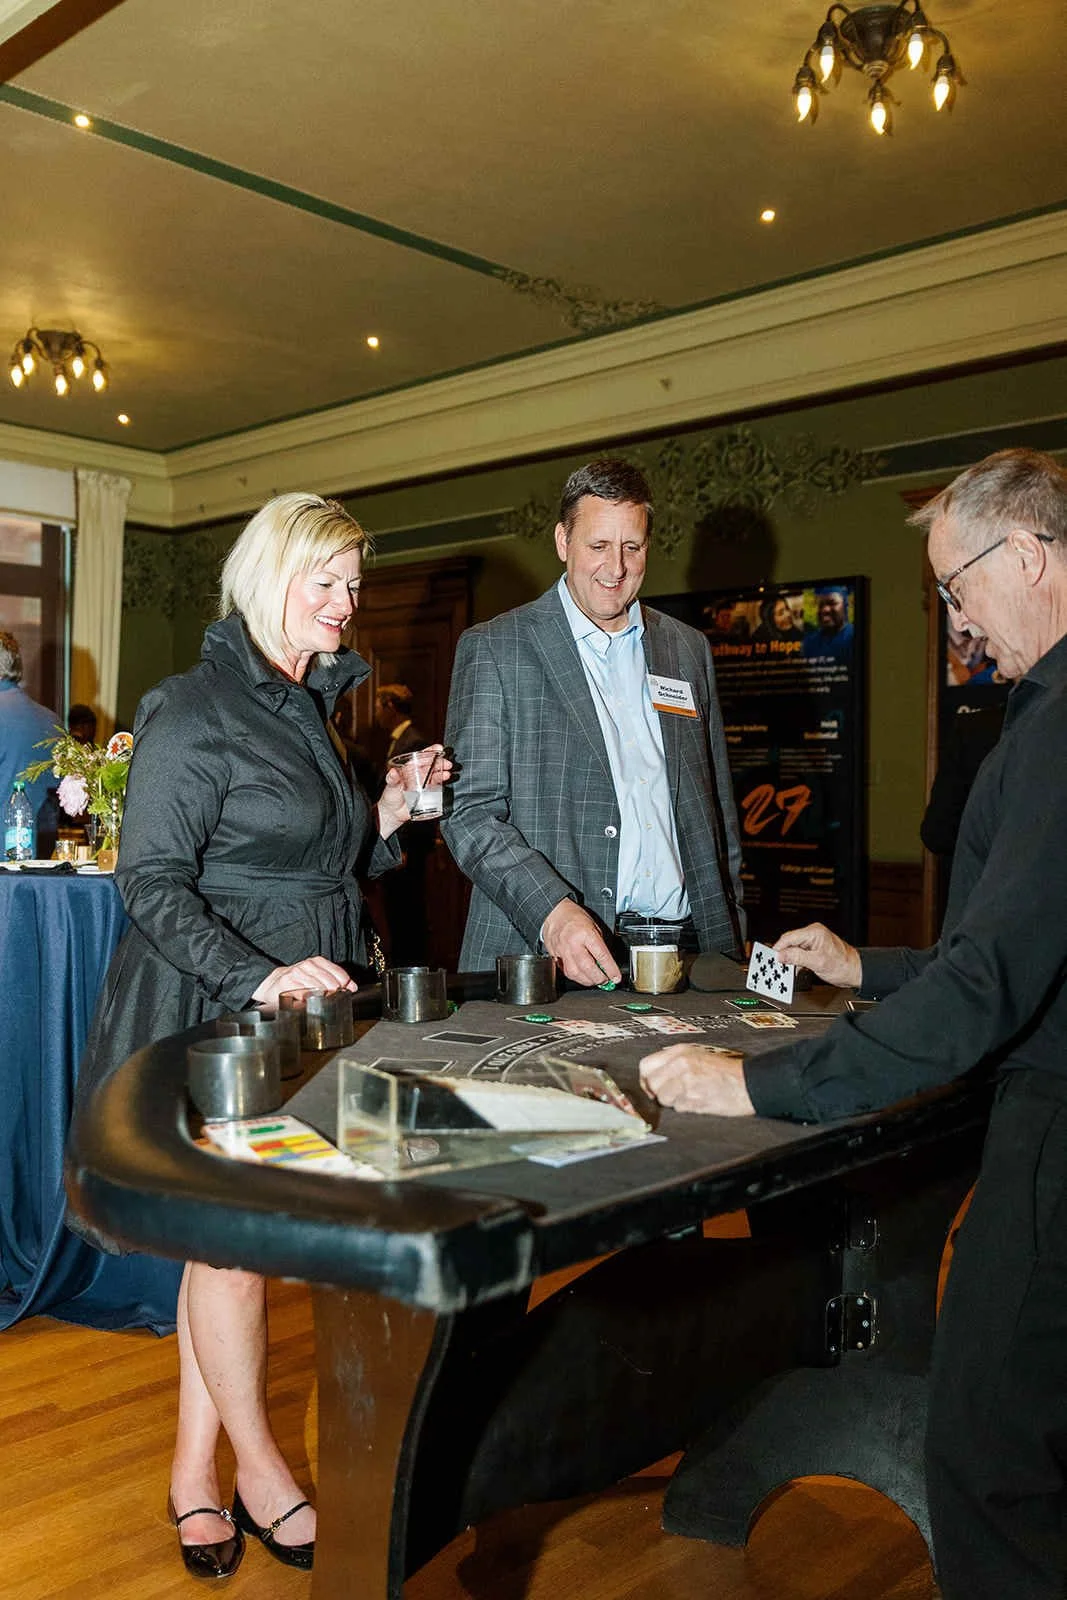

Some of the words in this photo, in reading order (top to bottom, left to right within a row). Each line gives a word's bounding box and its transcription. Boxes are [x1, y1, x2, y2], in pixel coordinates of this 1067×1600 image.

[710, 641, 753, 658] athway
[755, 641, 767, 654] to
[770, 640, 802, 655] Hope
[659, 685, 684, 694] Richard
[657, 691, 688, 701] Schneider
